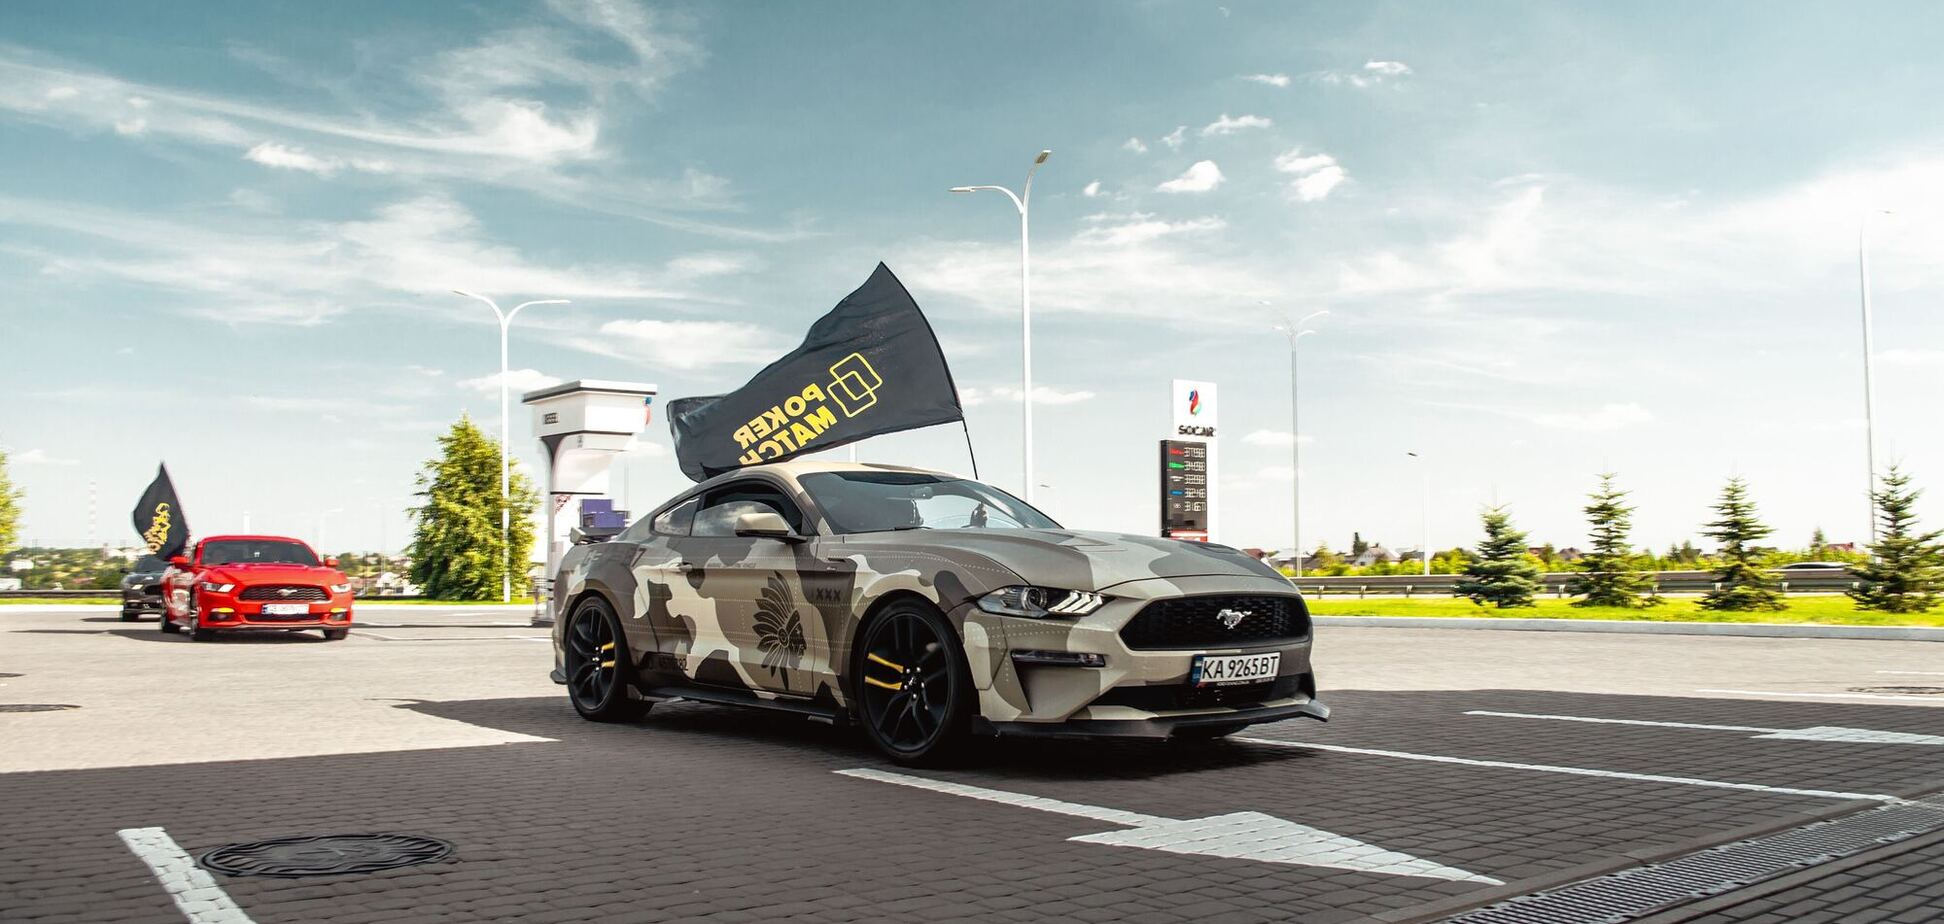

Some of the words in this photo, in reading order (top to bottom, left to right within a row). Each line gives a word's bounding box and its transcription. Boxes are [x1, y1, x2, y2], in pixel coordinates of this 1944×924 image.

[1178, 425, 1215, 437] SOCAR
[816, 588, 841, 601] XXX
[1202, 660, 1225, 679] KA
